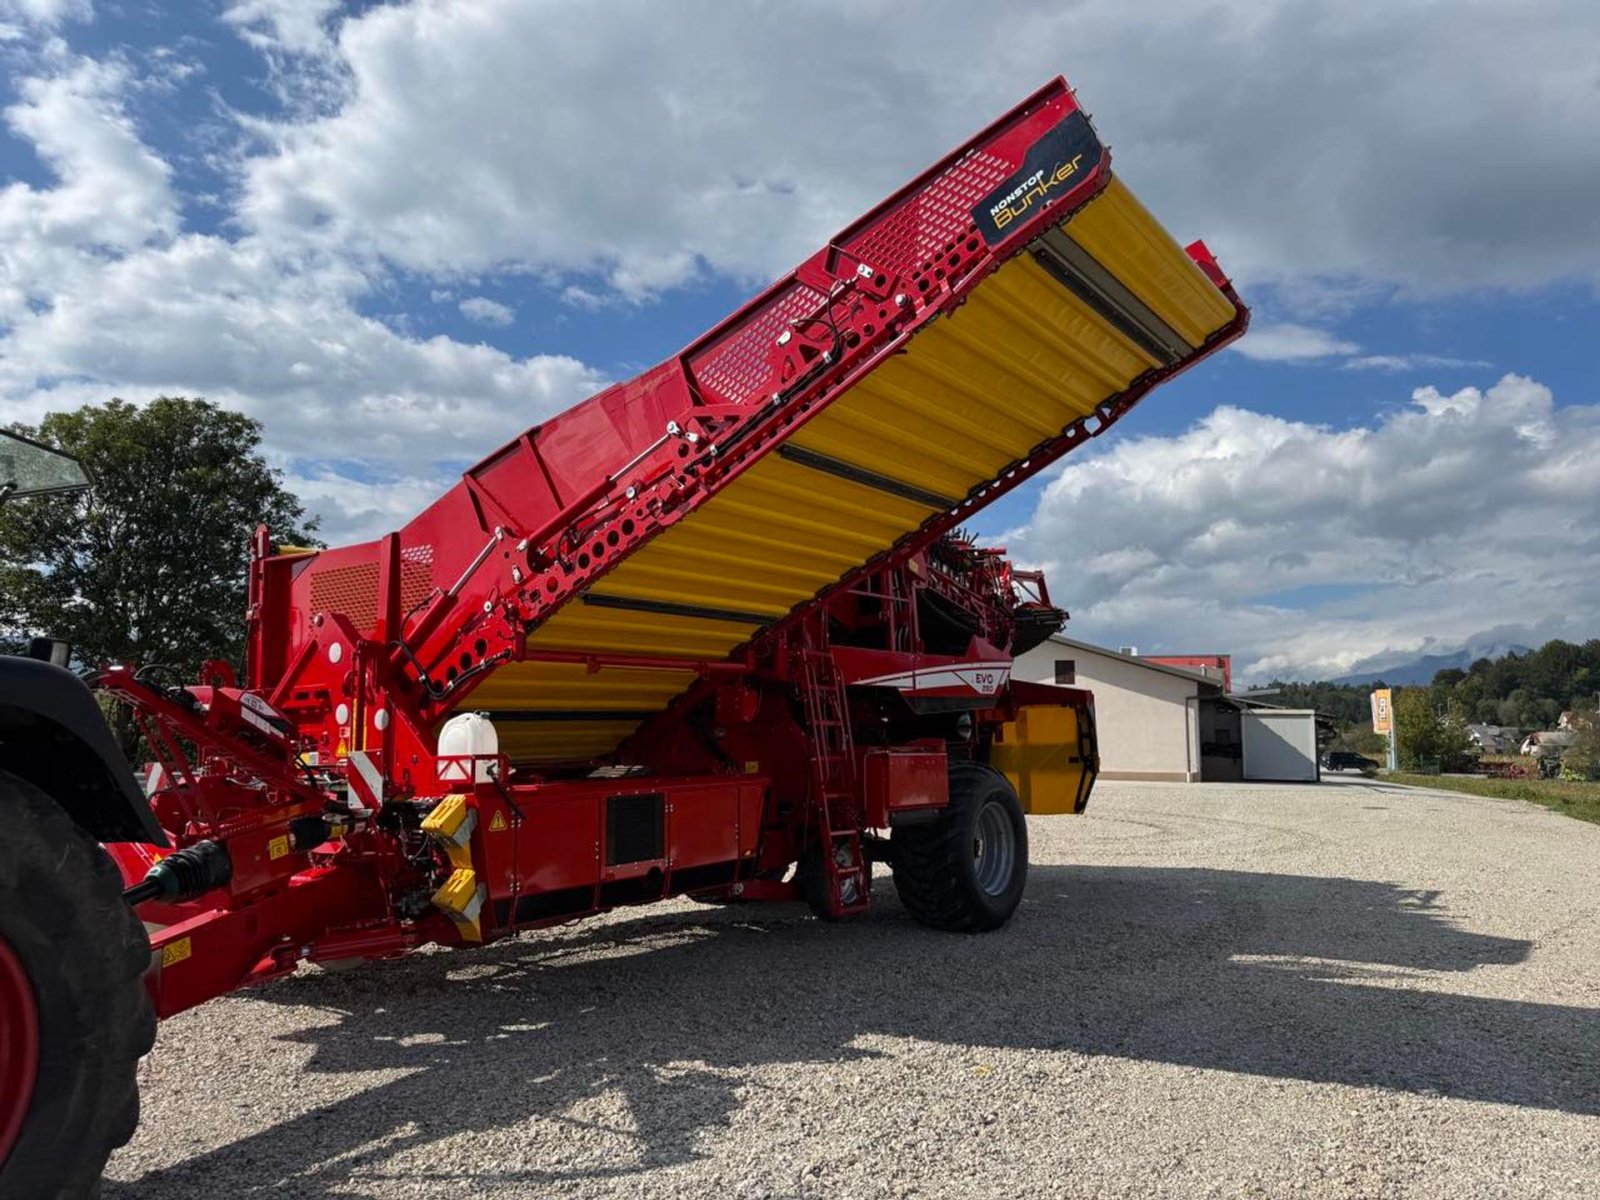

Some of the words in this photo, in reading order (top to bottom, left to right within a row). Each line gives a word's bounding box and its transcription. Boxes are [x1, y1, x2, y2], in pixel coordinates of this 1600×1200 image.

[990, 169, 1044, 216] NONSTOP
[993, 154, 1082, 229] Bunker
[976, 673, 993, 684] EVO
